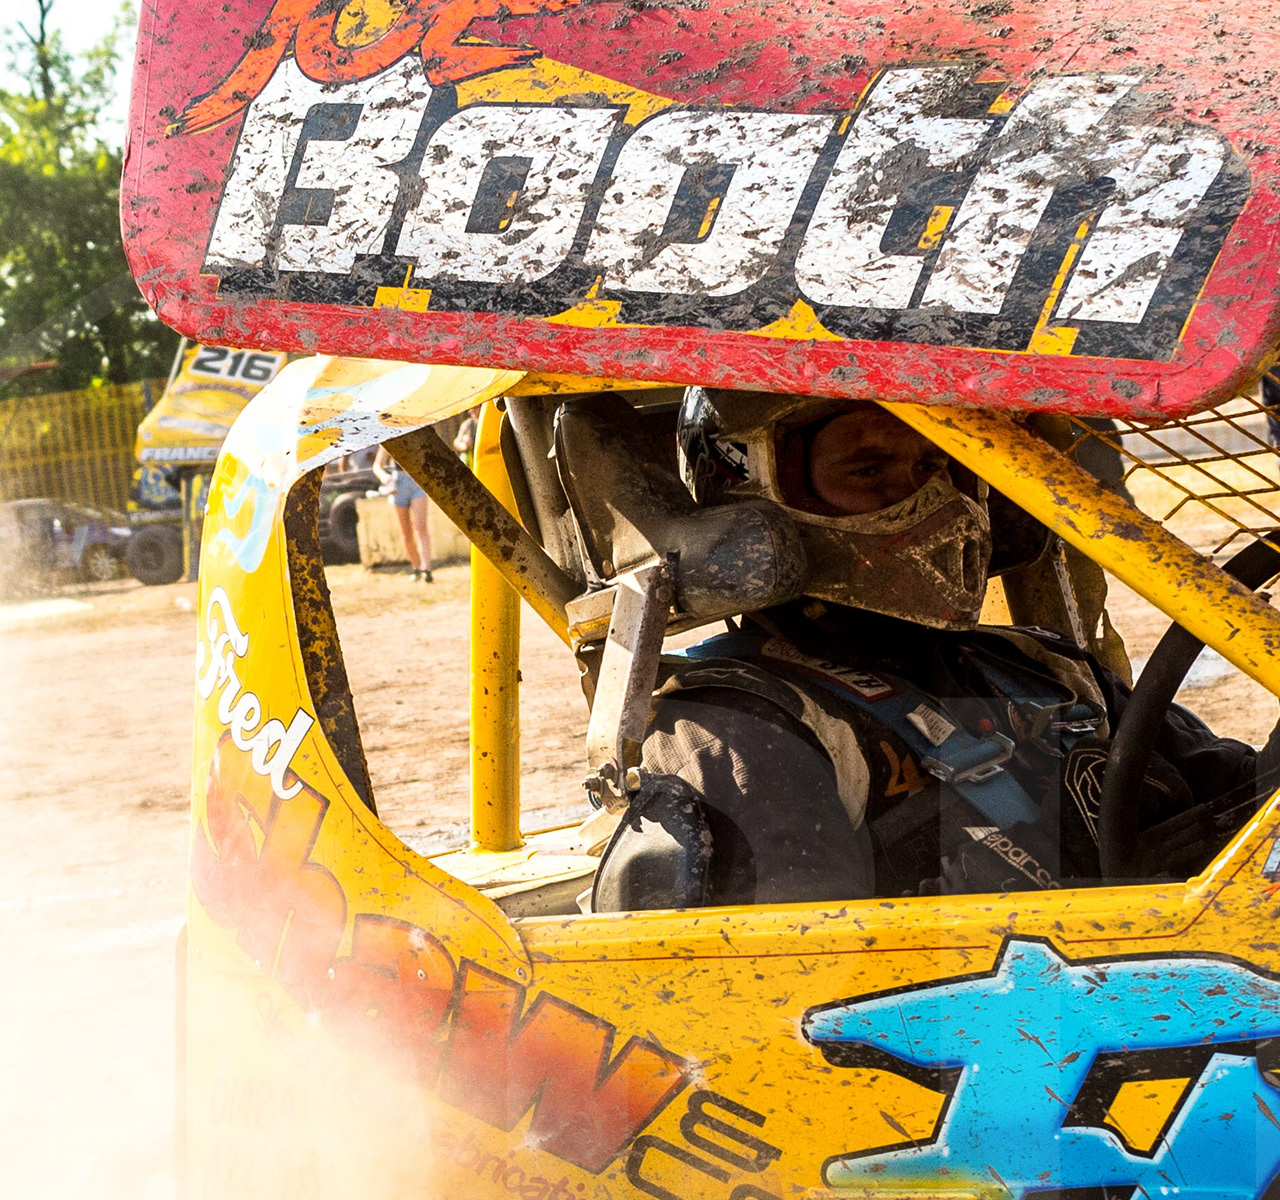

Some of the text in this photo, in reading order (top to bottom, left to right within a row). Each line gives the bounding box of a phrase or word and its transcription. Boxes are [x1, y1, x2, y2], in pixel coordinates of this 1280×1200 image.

[206, 58, 1235, 328] Booth
[192, 346, 277, 384] 216
[197, 586, 315, 801] Fred
